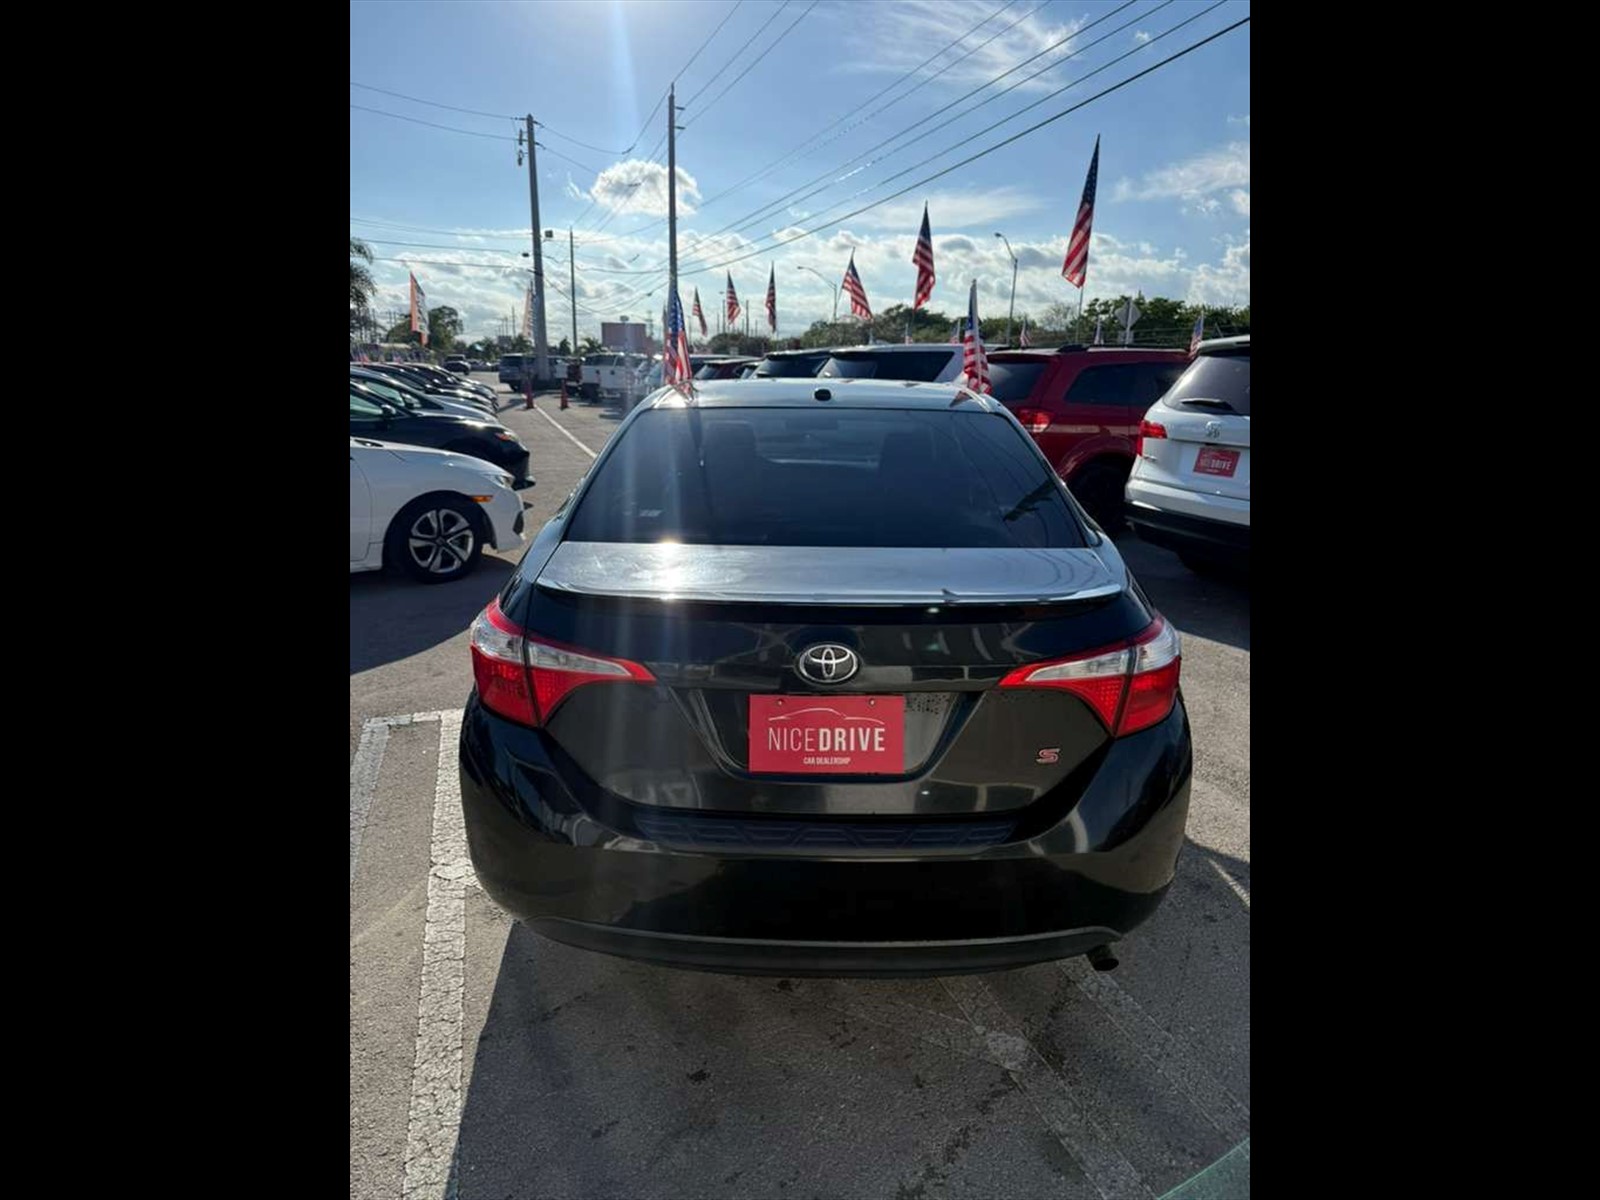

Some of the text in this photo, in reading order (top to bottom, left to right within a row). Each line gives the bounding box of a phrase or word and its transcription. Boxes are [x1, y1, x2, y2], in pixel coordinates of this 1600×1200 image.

[768, 727, 885, 752] NICEDRIVE
[803, 757, 851, 765] CAR DEALERSHIP
[1036, 748, 1060, 763] S
